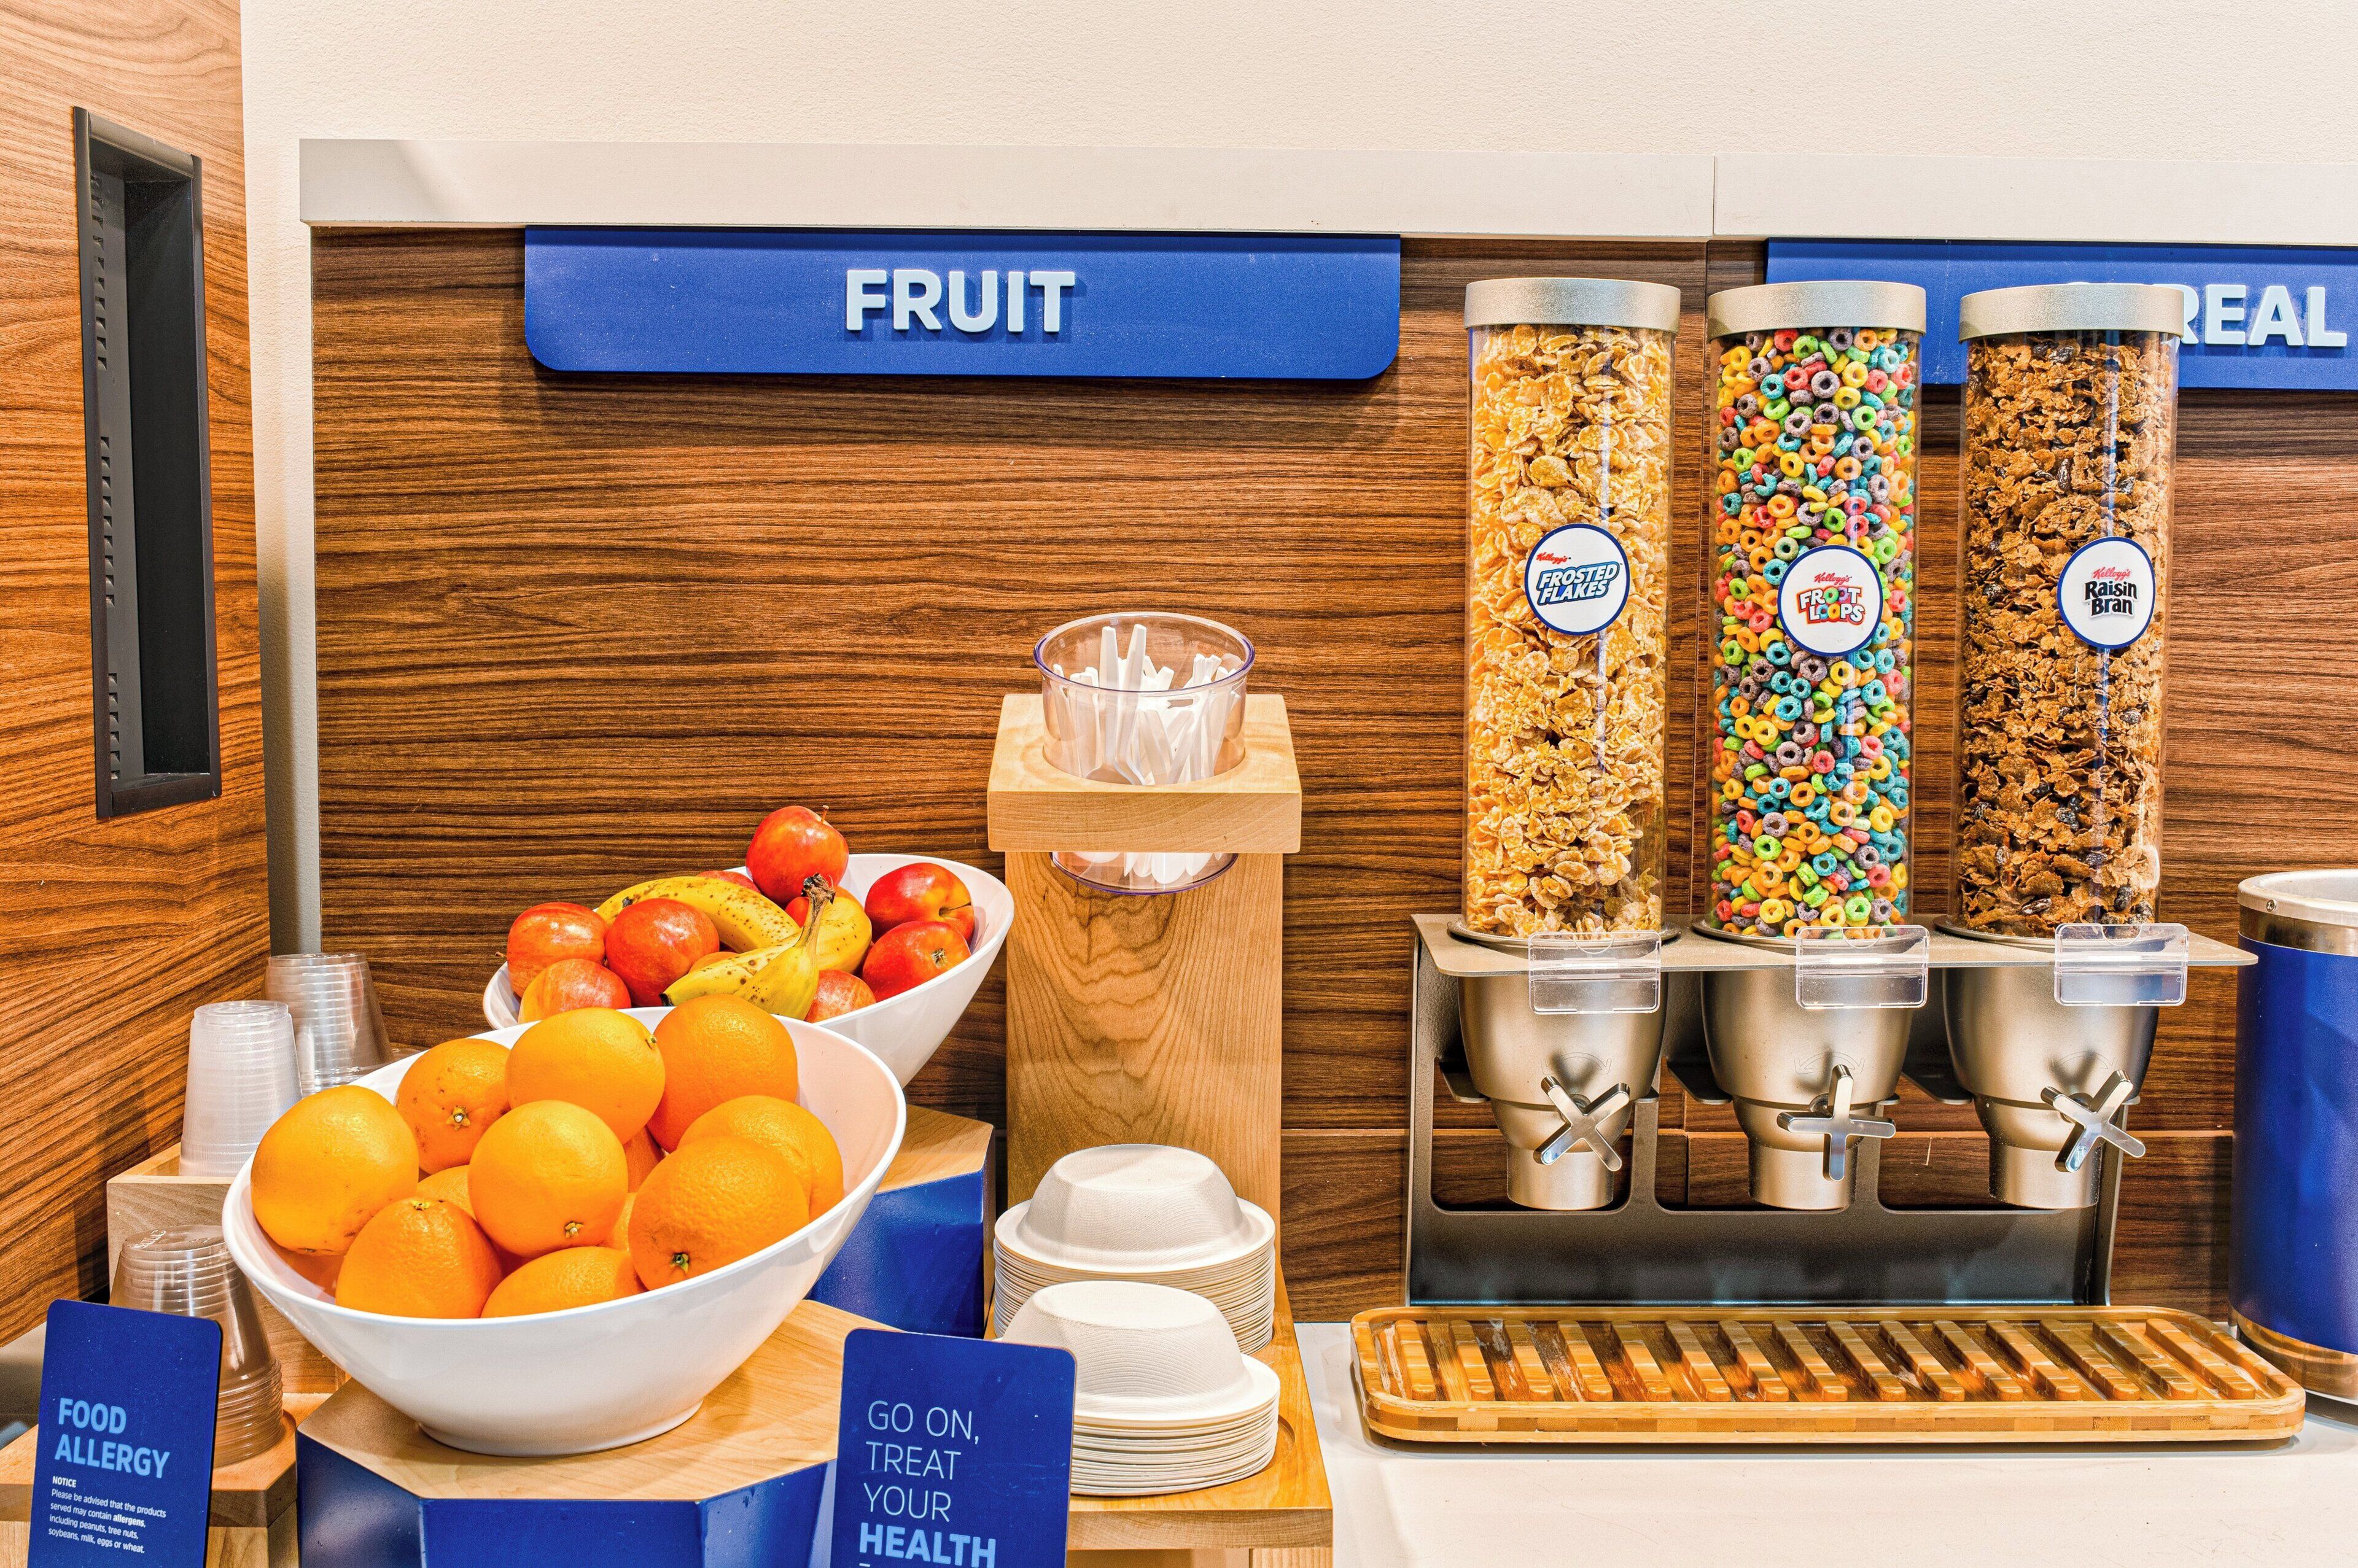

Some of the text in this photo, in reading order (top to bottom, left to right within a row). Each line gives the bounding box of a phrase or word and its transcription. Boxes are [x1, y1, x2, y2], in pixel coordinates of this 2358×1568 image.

[846, 270, 1075, 332] FRUIT
[1536, 552, 1568, 564] Kellogg's
[1538, 563, 1619, 589] FROSTED
[1814, 572, 1851, 585] Kellogg's
[2092, 566, 2131, 581] Kellogg's
[1539, 580, 1608, 604] FLAKES
[1799, 587, 1862, 610] FROOT
[2084, 581, 2138, 600] Raisin
[1808, 603, 1865, 623] LOOPS
[2091, 597, 2133, 616] Bran
[58, 1397, 126, 1435] FOOD
[868, 1400, 979, 1445] GO ON,
[55, 1434, 170, 1479] ALLERGY
[866, 1441, 961, 1480] TREAT
[52, 1476, 77, 1488] NOTICE
[50, 1503, 146, 1528] served may contain allergens,
[52, 1488, 166, 1518] Please be advised that the products
[863, 1483, 951, 1523] YOUR
[49, 1514, 139, 1540] including peanuts, tree nuts,
[49, 1527, 80, 1541] soybeans,
[81, 1534, 96, 1545] milk,
[97, 1538, 113, 1548] eggs
[123, 1542, 145, 1554] wheat.
[860, 1522, 996, 1568] HEALTH
